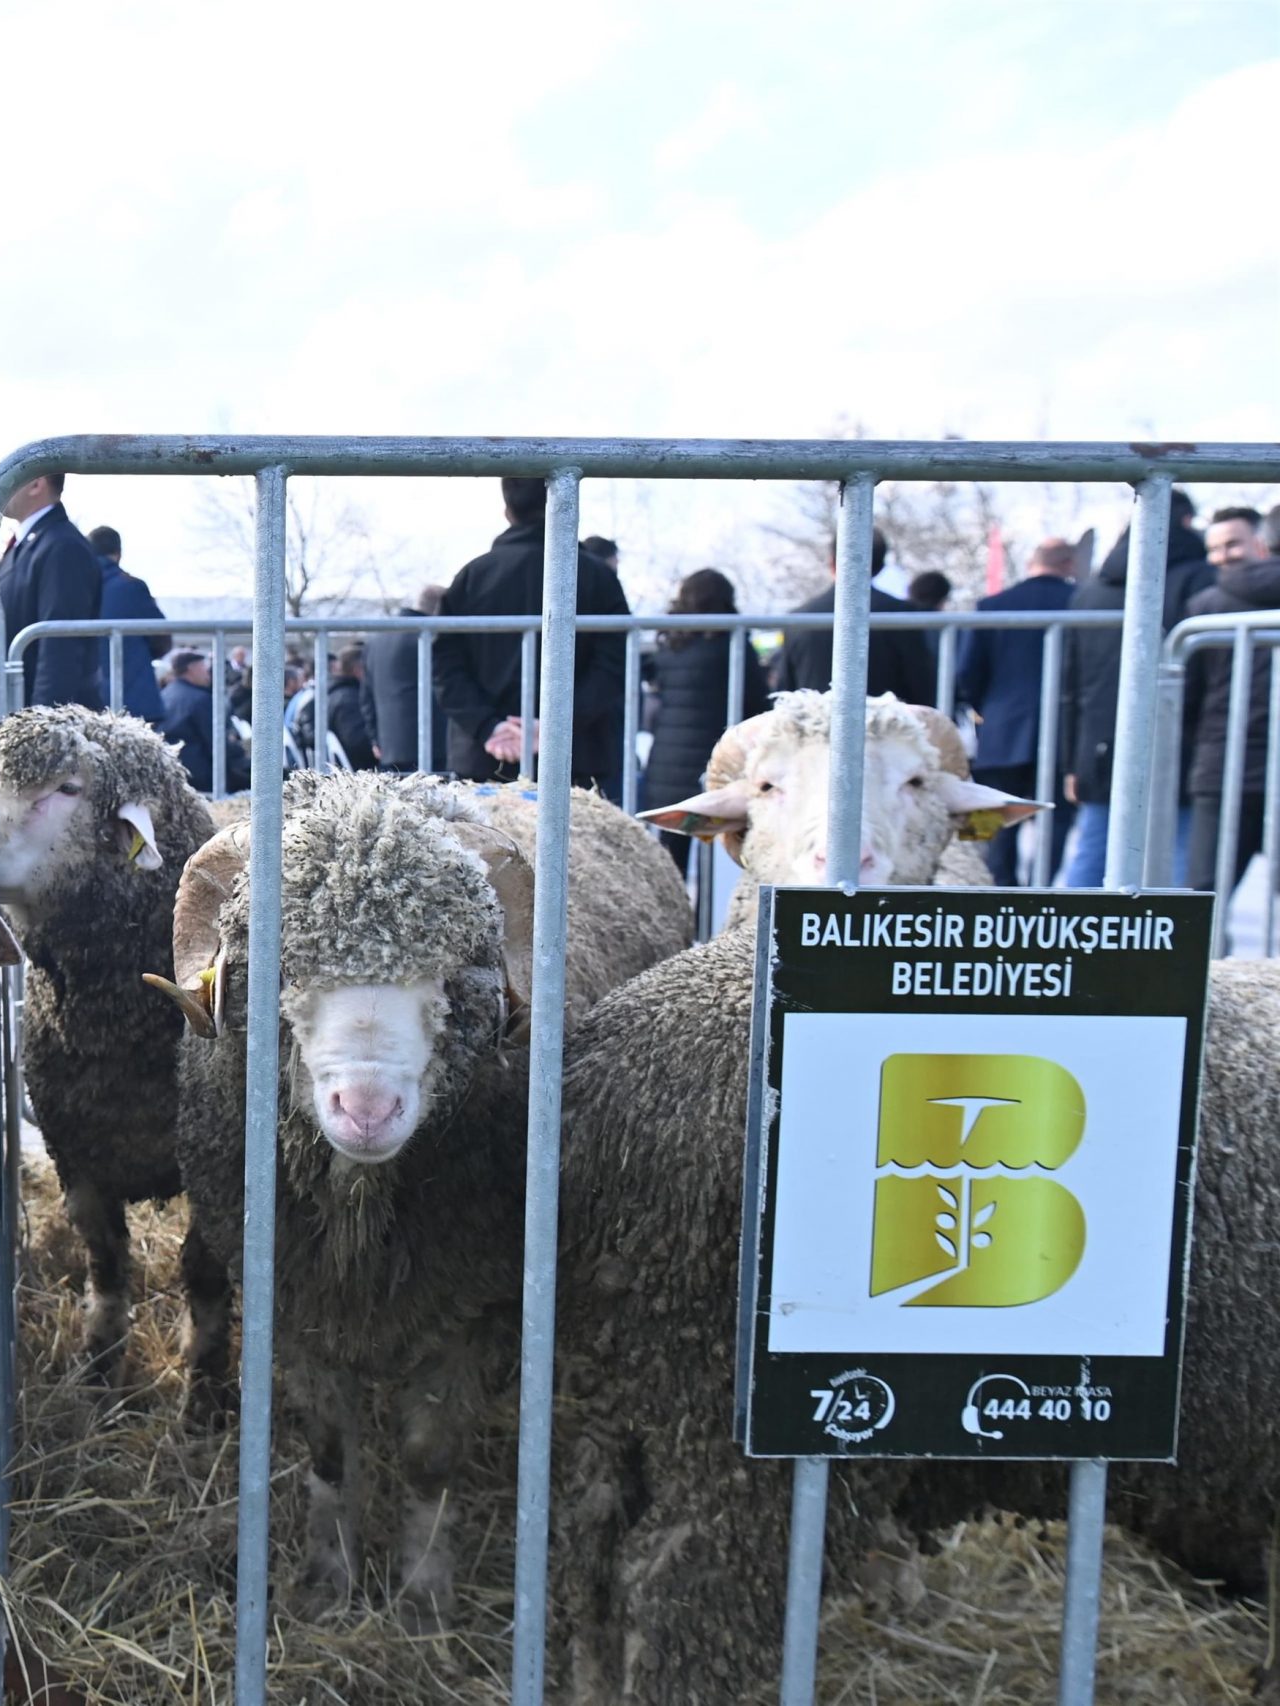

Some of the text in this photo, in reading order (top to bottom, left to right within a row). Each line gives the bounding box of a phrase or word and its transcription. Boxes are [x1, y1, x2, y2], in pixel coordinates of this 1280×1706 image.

[801, 906, 1174, 954] BALIKESİR BÜYÜKŞEHİR
[891, 955, 1073, 997] BELEDİYESİ
[1031, 1385, 1072, 1397] BEYAZ
[983, 1398, 1111, 1421] 444 40 10
